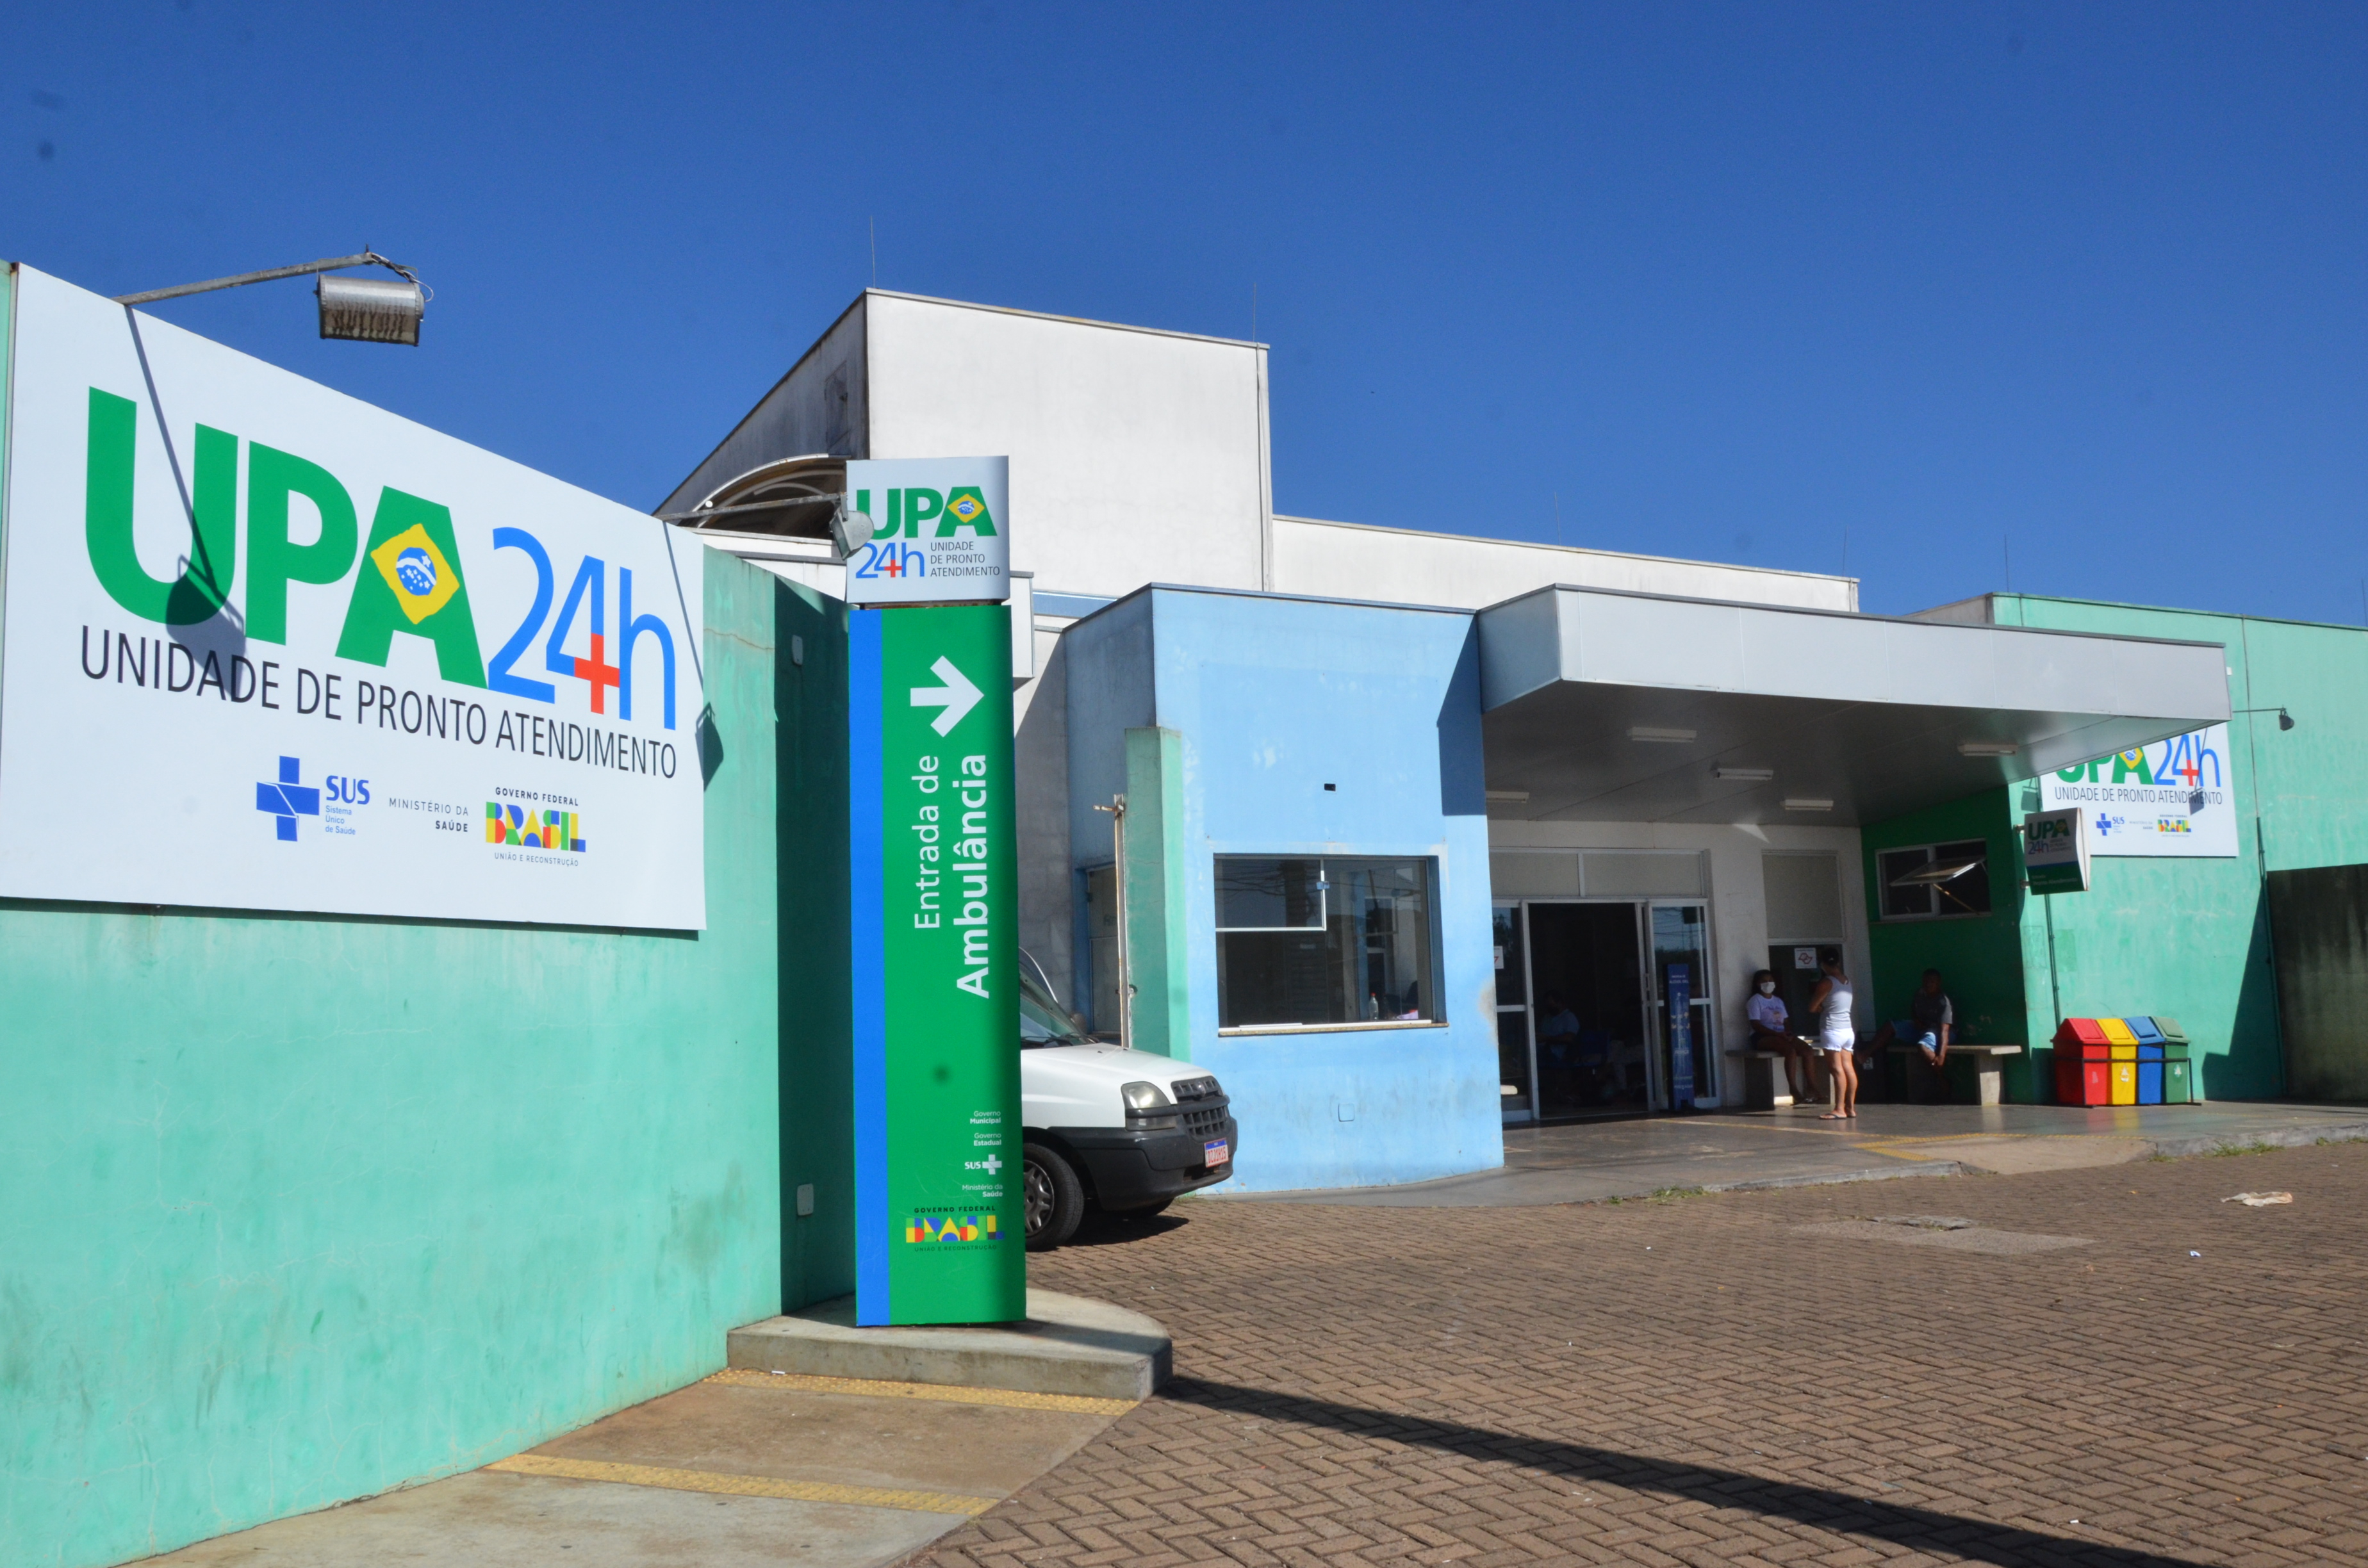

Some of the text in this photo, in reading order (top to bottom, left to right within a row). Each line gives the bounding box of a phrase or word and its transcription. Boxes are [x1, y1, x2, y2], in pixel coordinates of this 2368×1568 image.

[857, 486, 998, 540] UPA
[930, 541, 974, 551] UNIDADE
[85, 386, 676, 730] UPA 24h
[855, 542, 925, 578] 24h
[930, 553, 985, 564] DE PRONTO
[930, 566, 1000, 577] ATENDIMENTO
[82, 625, 677, 779] UNIDADE DE PRONTO ATENDIMENTO
[2153, 734, 2221, 787] 24h
[325, 775, 370, 805] SUS
[495, 787, 579, 806] GOVERNO FEDERAL
[2055, 787, 2223, 805] UNIDADE DE PRONTO ATENDIMENTO
[325, 805, 352, 815] Sistema
[389, 797, 468, 817] MINISTÉRIO DA
[325, 815, 345, 824] Único
[436, 819, 468, 833] SAÚDE
[486, 801, 586, 853] BRASIL
[2112, 816, 2125, 824] SUS
[2157, 819, 2192, 832] BRASIL
[335, 825, 356, 835] Saúde
[2028, 819, 2070, 840] UPA
[912, 755, 940, 929] Entrada de
[2028, 840, 2050, 854] 24h
[495, 851, 517, 861] UNIÃO
[526, 855, 579, 867] RECONSTRUÇÃO
[953, 755, 989, 999] Ambulância
[964, 1161, 981, 1170] SUS
[906, 1215, 1005, 1243] BRASIL
